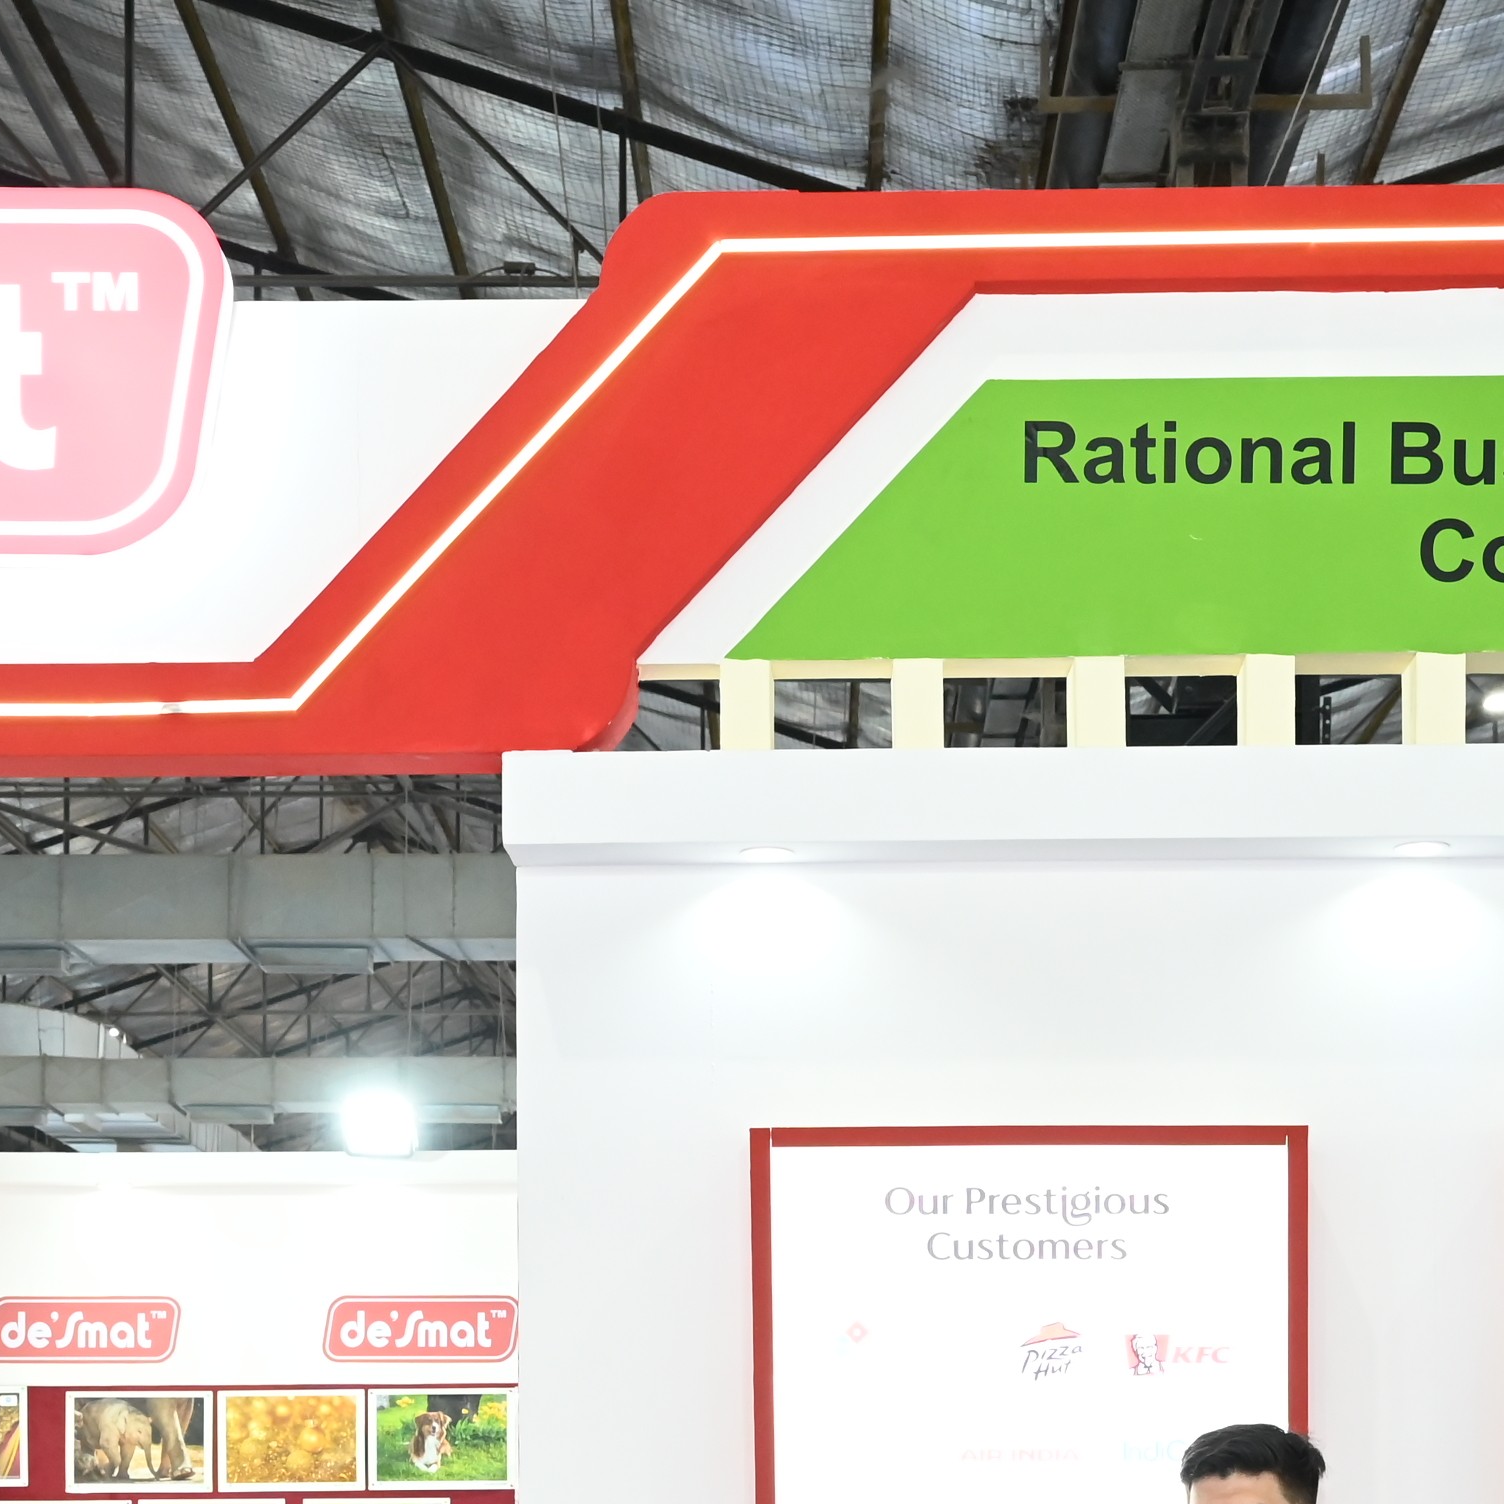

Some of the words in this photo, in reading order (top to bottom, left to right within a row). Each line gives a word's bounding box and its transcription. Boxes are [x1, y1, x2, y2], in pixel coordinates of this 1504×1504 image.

[1024, 420, 1356, 485] Rational
[884, 1186, 954, 1216] Our
[965, 1186, 1171, 1227] Prestigious
[926, 1232, 1128, 1262] Customers
[1172, 1345, 1231, 1365] KFC
